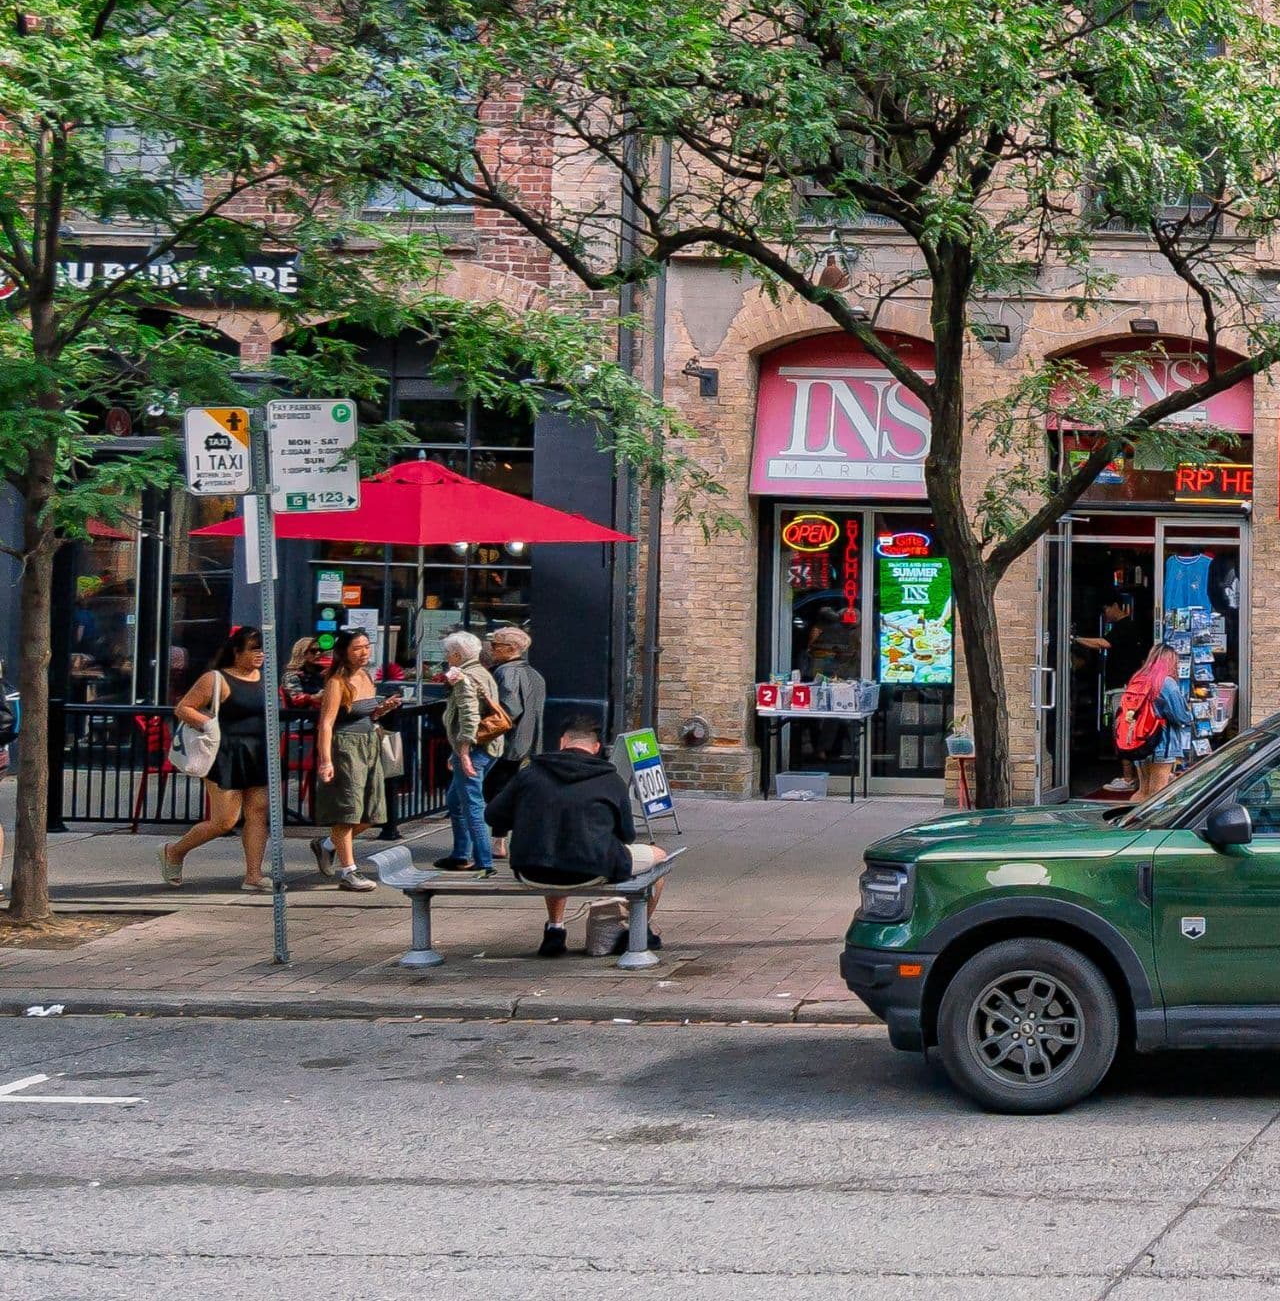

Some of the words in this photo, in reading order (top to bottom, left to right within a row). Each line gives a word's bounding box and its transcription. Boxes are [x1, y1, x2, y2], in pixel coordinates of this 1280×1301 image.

[779, 379, 932, 460] INS
[195, 455, 200, 470] 1
[208, 454, 243, 470] TAXI
[308, 492, 344, 503] 4123
[786, 525, 834, 543] OPEN
[892, 567, 938, 577] SUMMER
[903, 585, 928, 600] INS
[763, 690, 772, 701] 2
